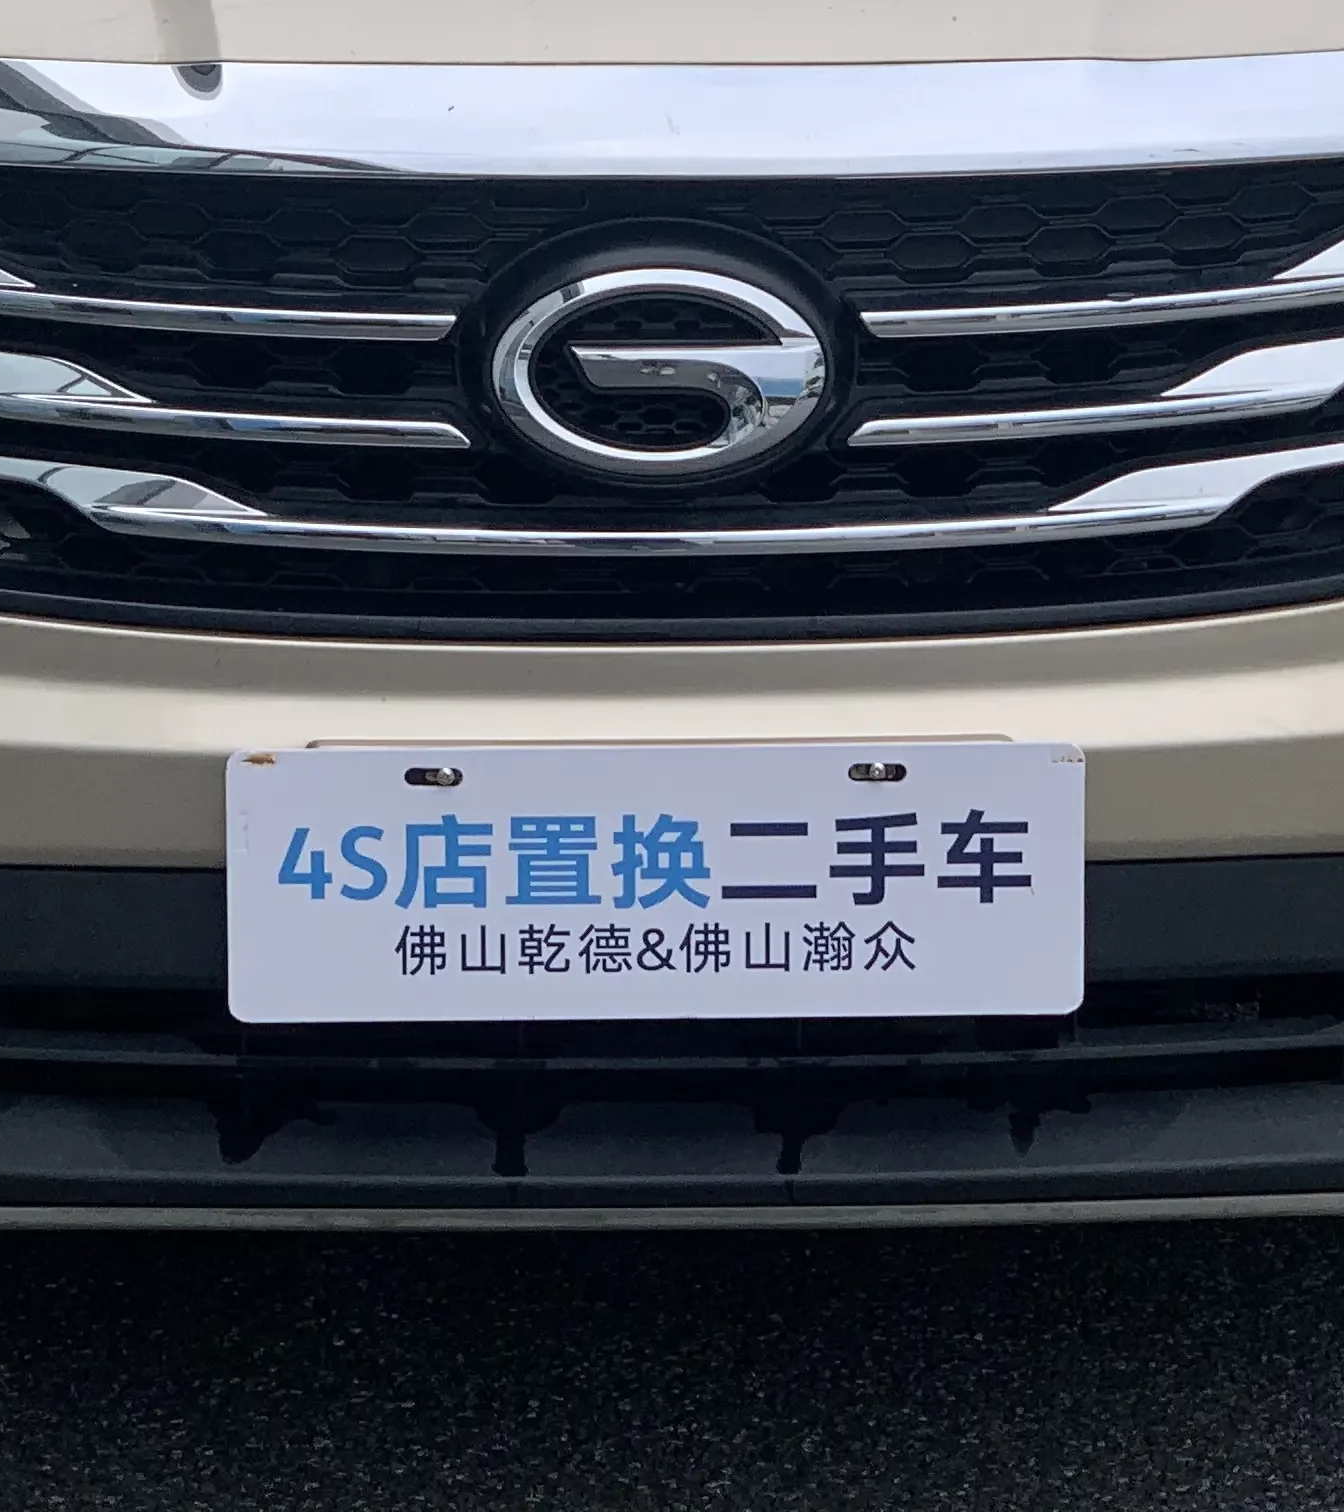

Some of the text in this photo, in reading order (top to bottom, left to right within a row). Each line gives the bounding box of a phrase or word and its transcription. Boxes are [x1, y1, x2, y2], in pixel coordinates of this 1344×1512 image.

[277, 808, 1033, 910] 4S店置换二手车
[394, 920, 917, 976] 佛山乾德&佛山瀚众
